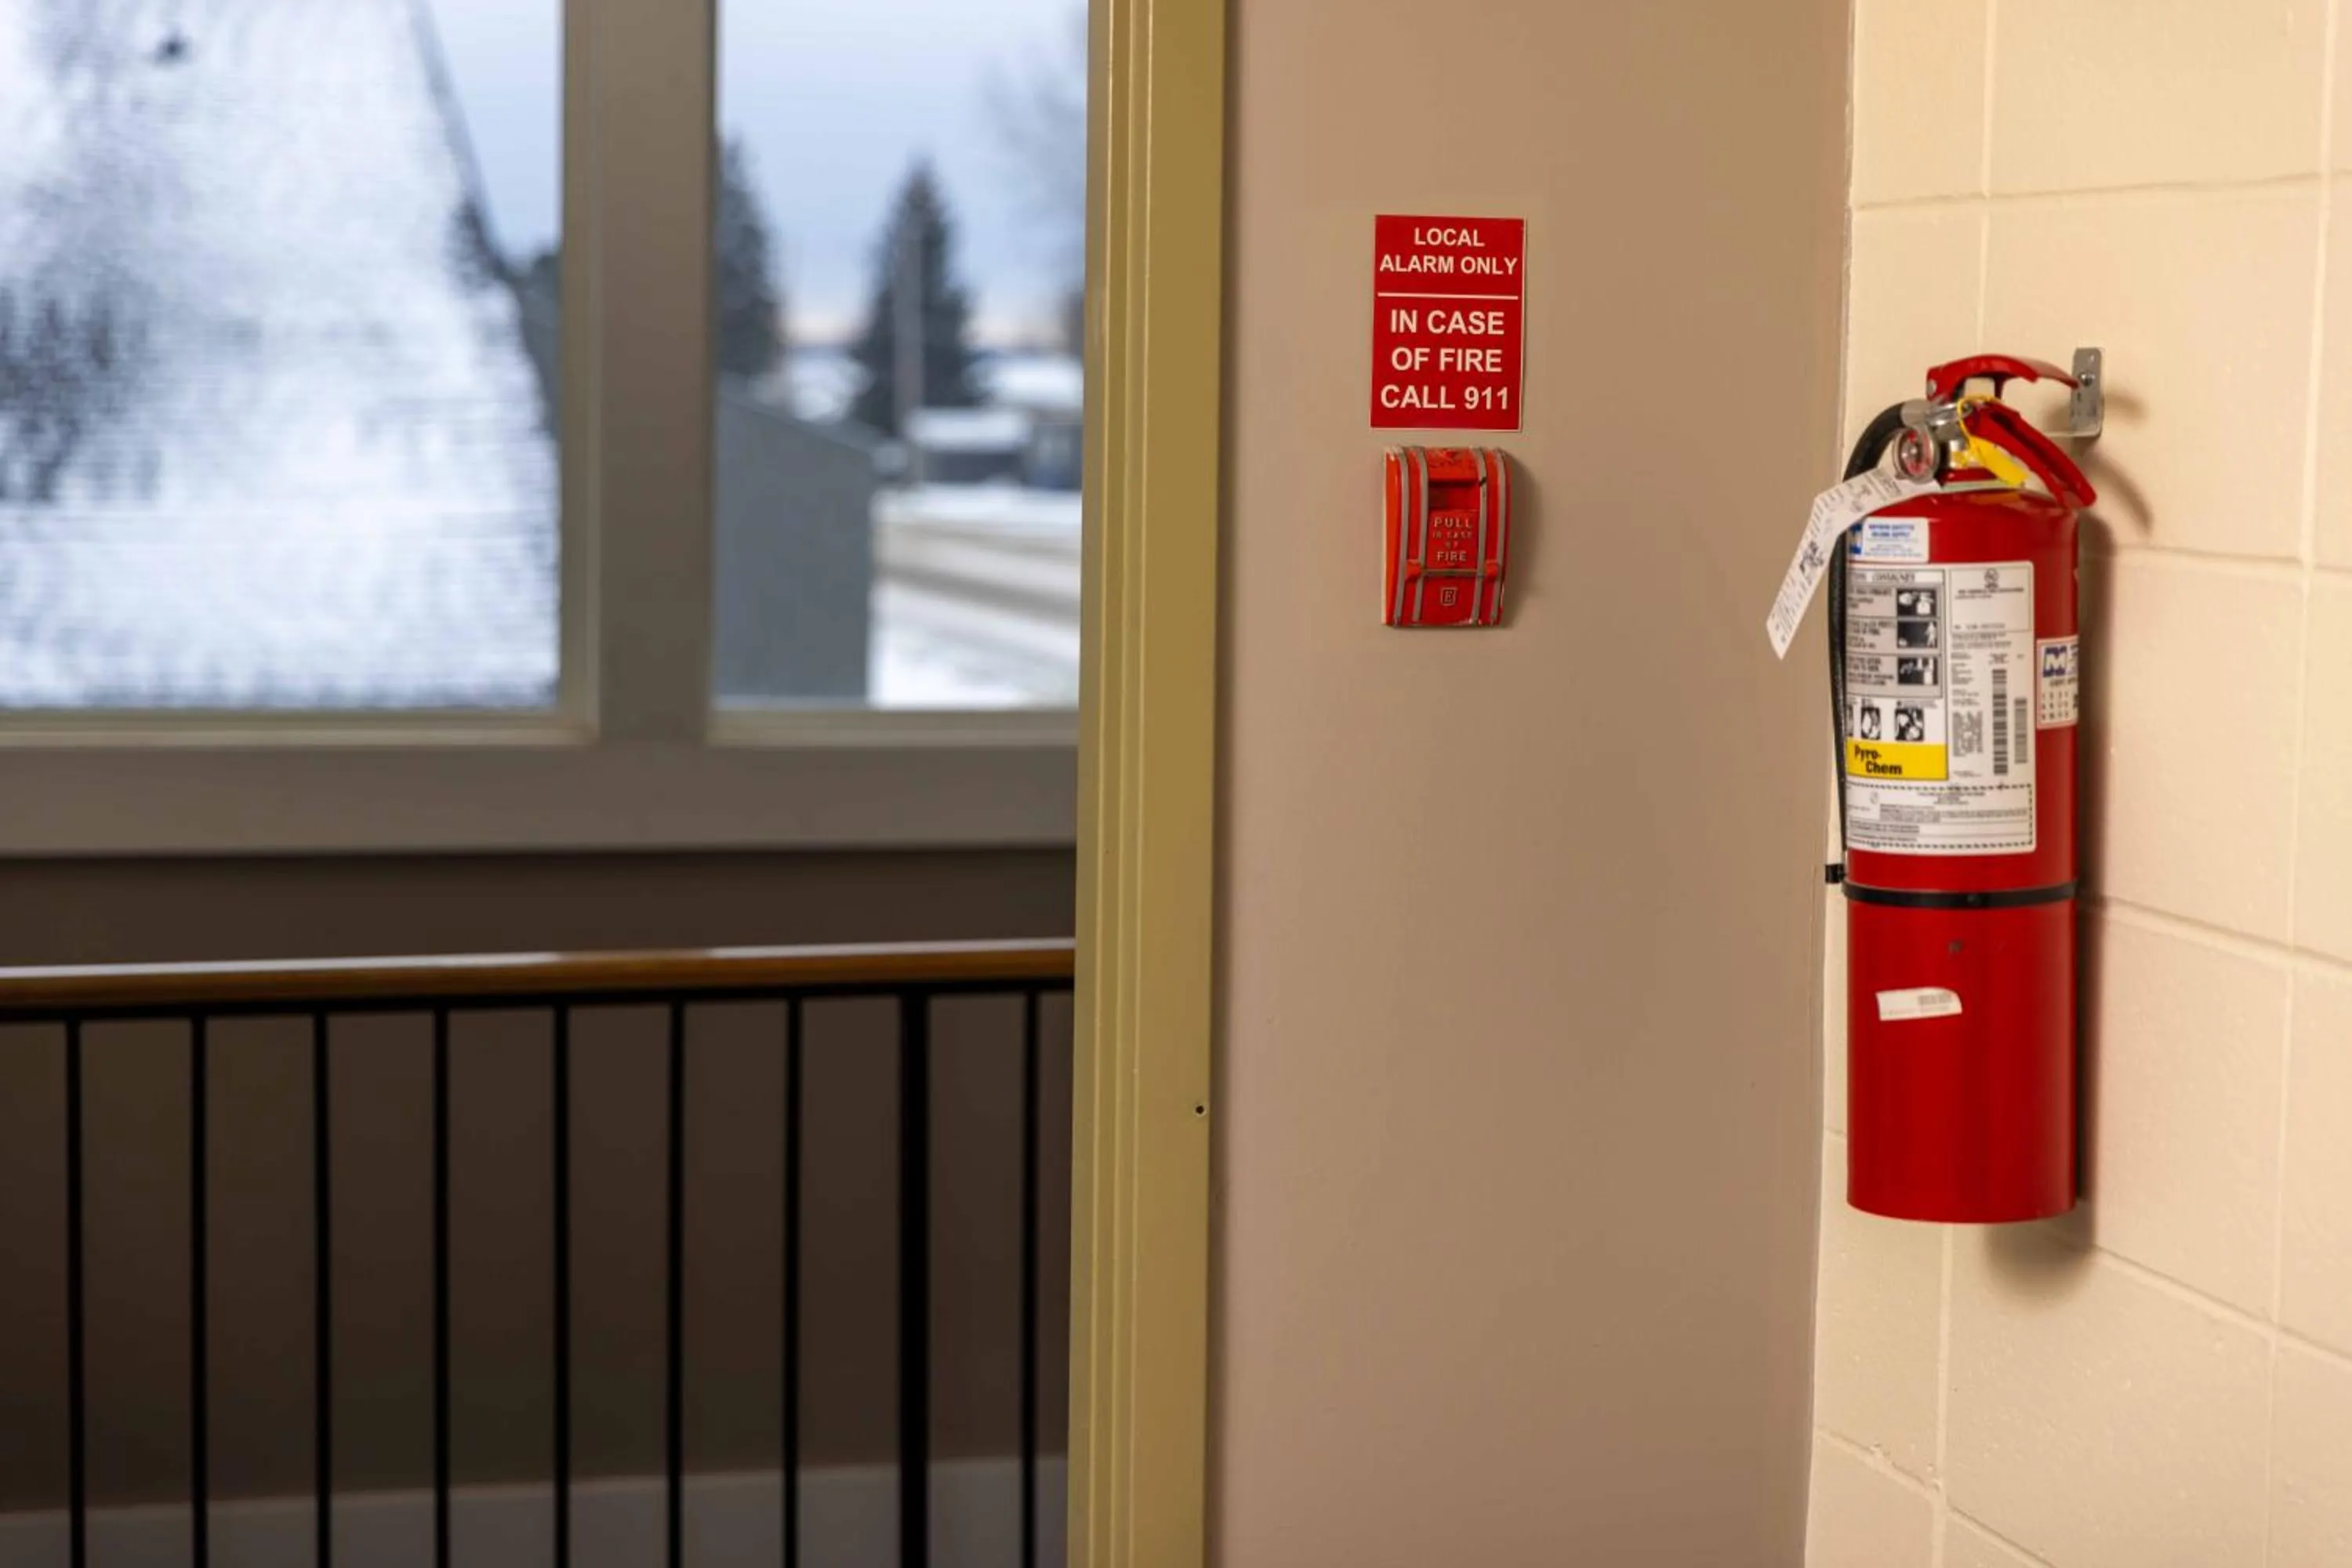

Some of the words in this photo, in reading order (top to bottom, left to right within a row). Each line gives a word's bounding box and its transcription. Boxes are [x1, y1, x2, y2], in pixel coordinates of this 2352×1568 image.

[1414, 227, 1484, 247] LOCAL
[1380, 254, 1454, 274] ALARM
[1461, 256, 1518, 275] ONLY
[1391, 310, 1417, 333] IN
[1426, 310, 1504, 335] CASE
[1391, 347, 1430, 371] OF
[1439, 348, 1502, 372] FIRE
[1380, 384, 1456, 408] CALL
[1464, 387, 1508, 409] 911
[1433, 517, 1473, 528] PULL
[1436, 550, 1468, 562] FIRE
[1853, 744, 1882, 761] Pyro-
[1865, 760, 1904, 775] Chem
